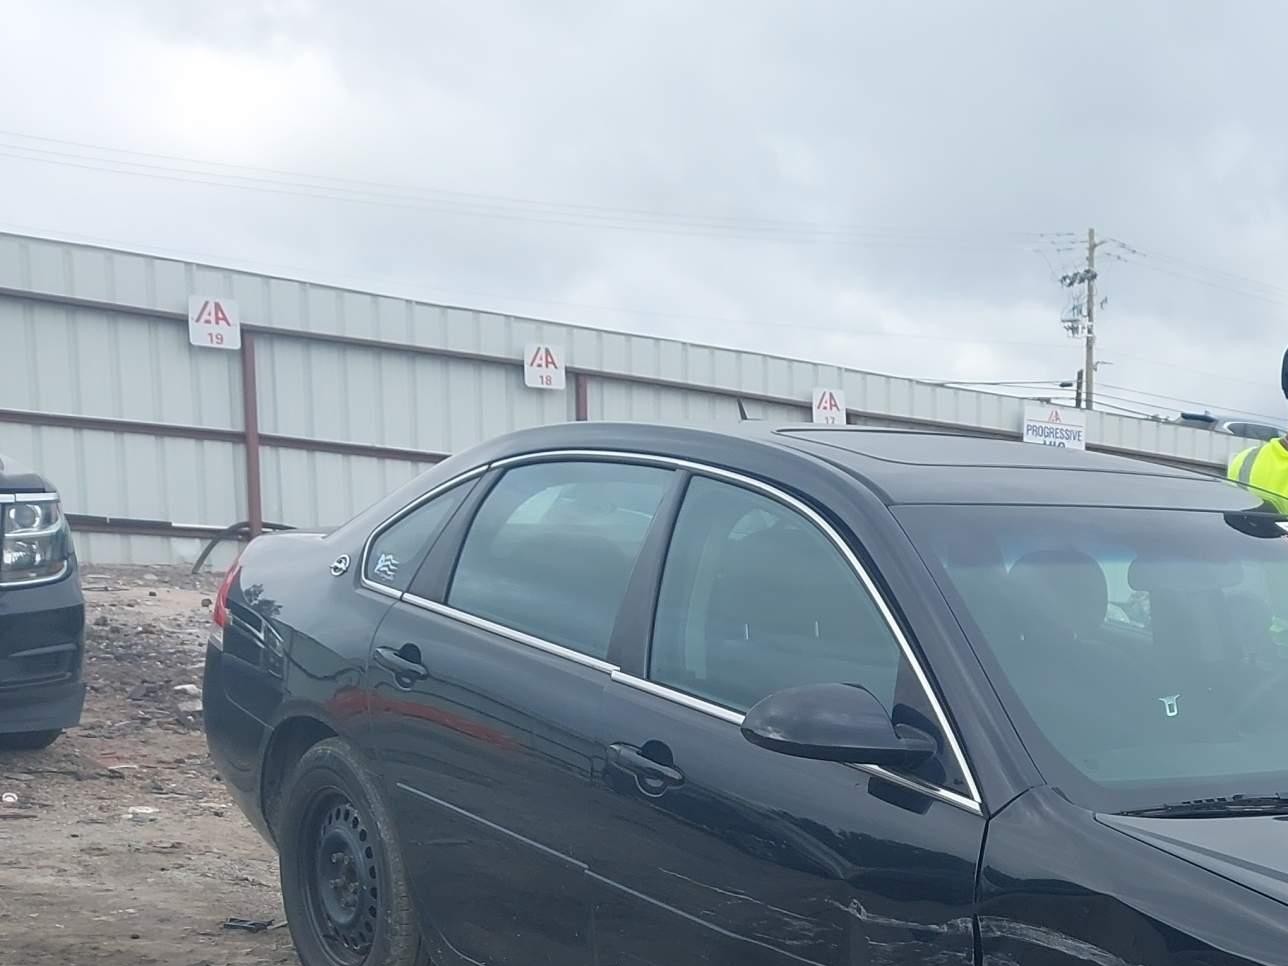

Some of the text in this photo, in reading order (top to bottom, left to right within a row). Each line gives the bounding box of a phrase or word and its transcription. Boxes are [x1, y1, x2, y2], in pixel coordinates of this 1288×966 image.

[208, 332, 224, 345] 19
[539, 375, 552, 386] 18
[1026, 423, 1083, 442] PROGRESSIVE
